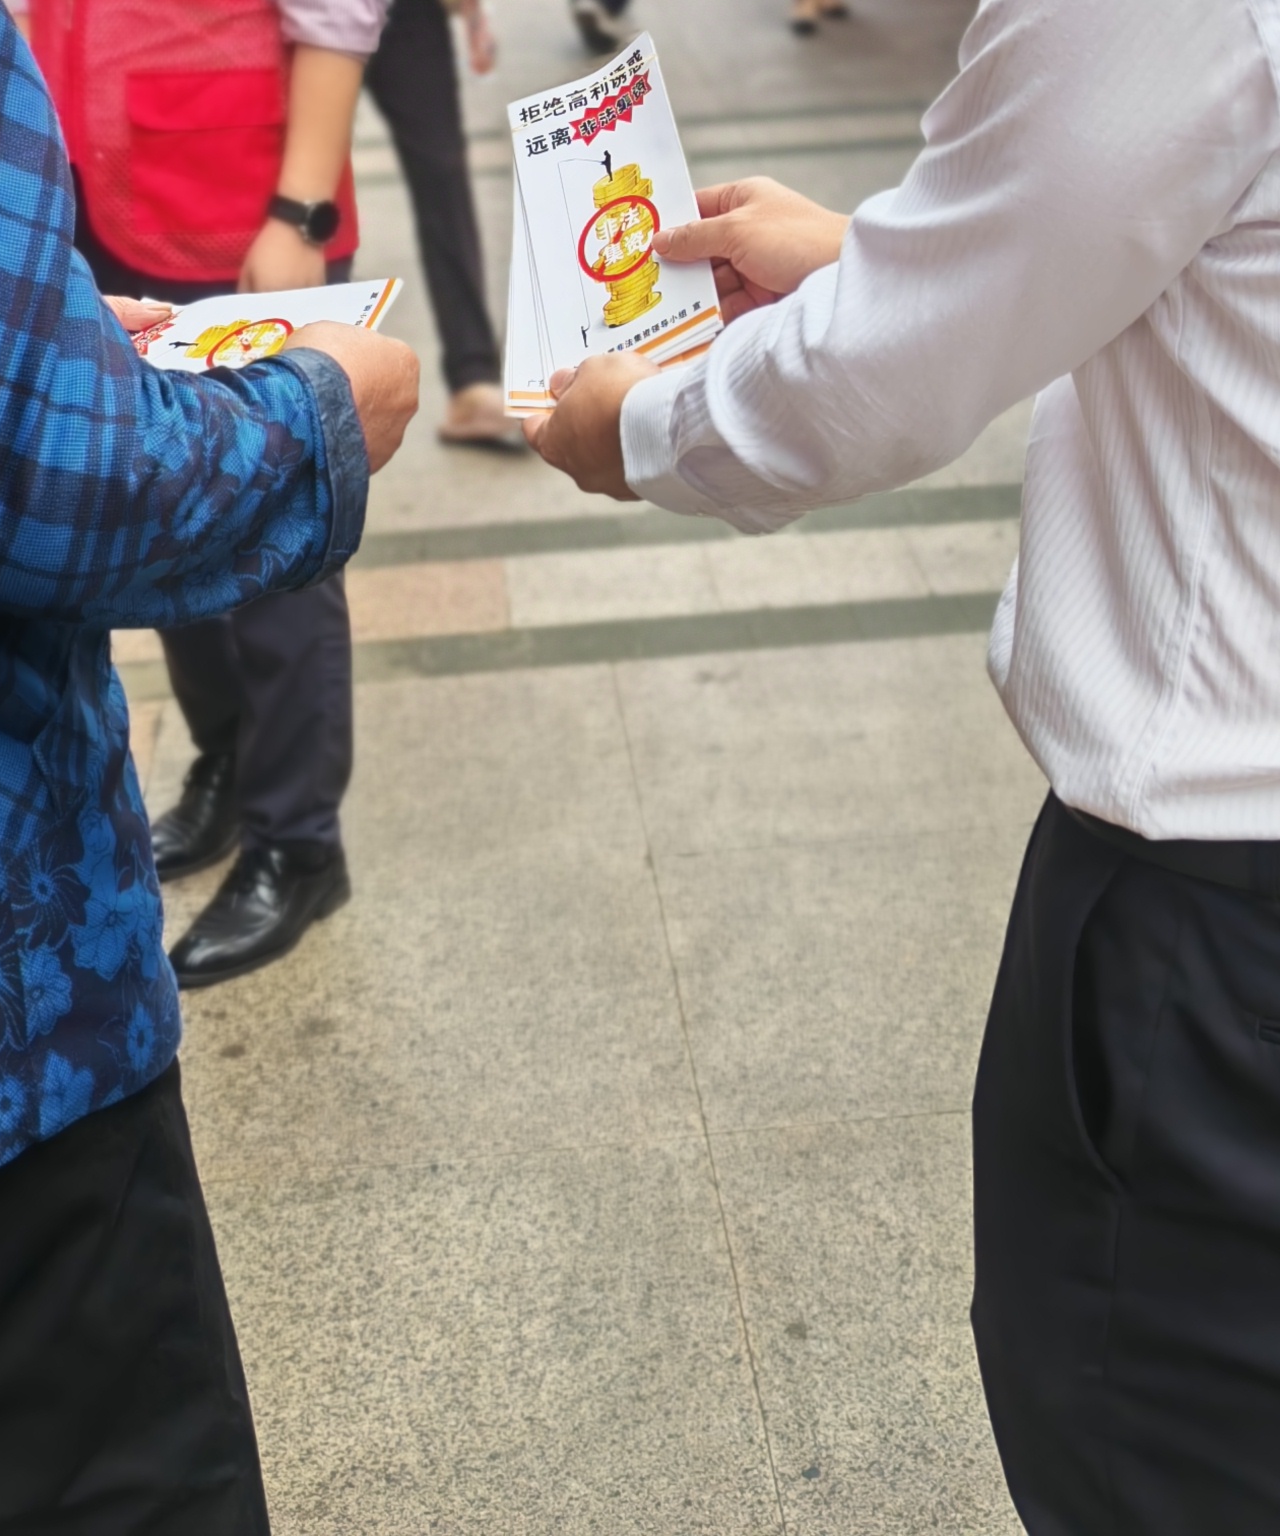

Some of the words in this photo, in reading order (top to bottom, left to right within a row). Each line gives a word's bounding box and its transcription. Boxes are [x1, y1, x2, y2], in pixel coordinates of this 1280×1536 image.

[519, 49, 645, 127] 拒绝高利诱惑
[595, 206, 641, 245] 非法
